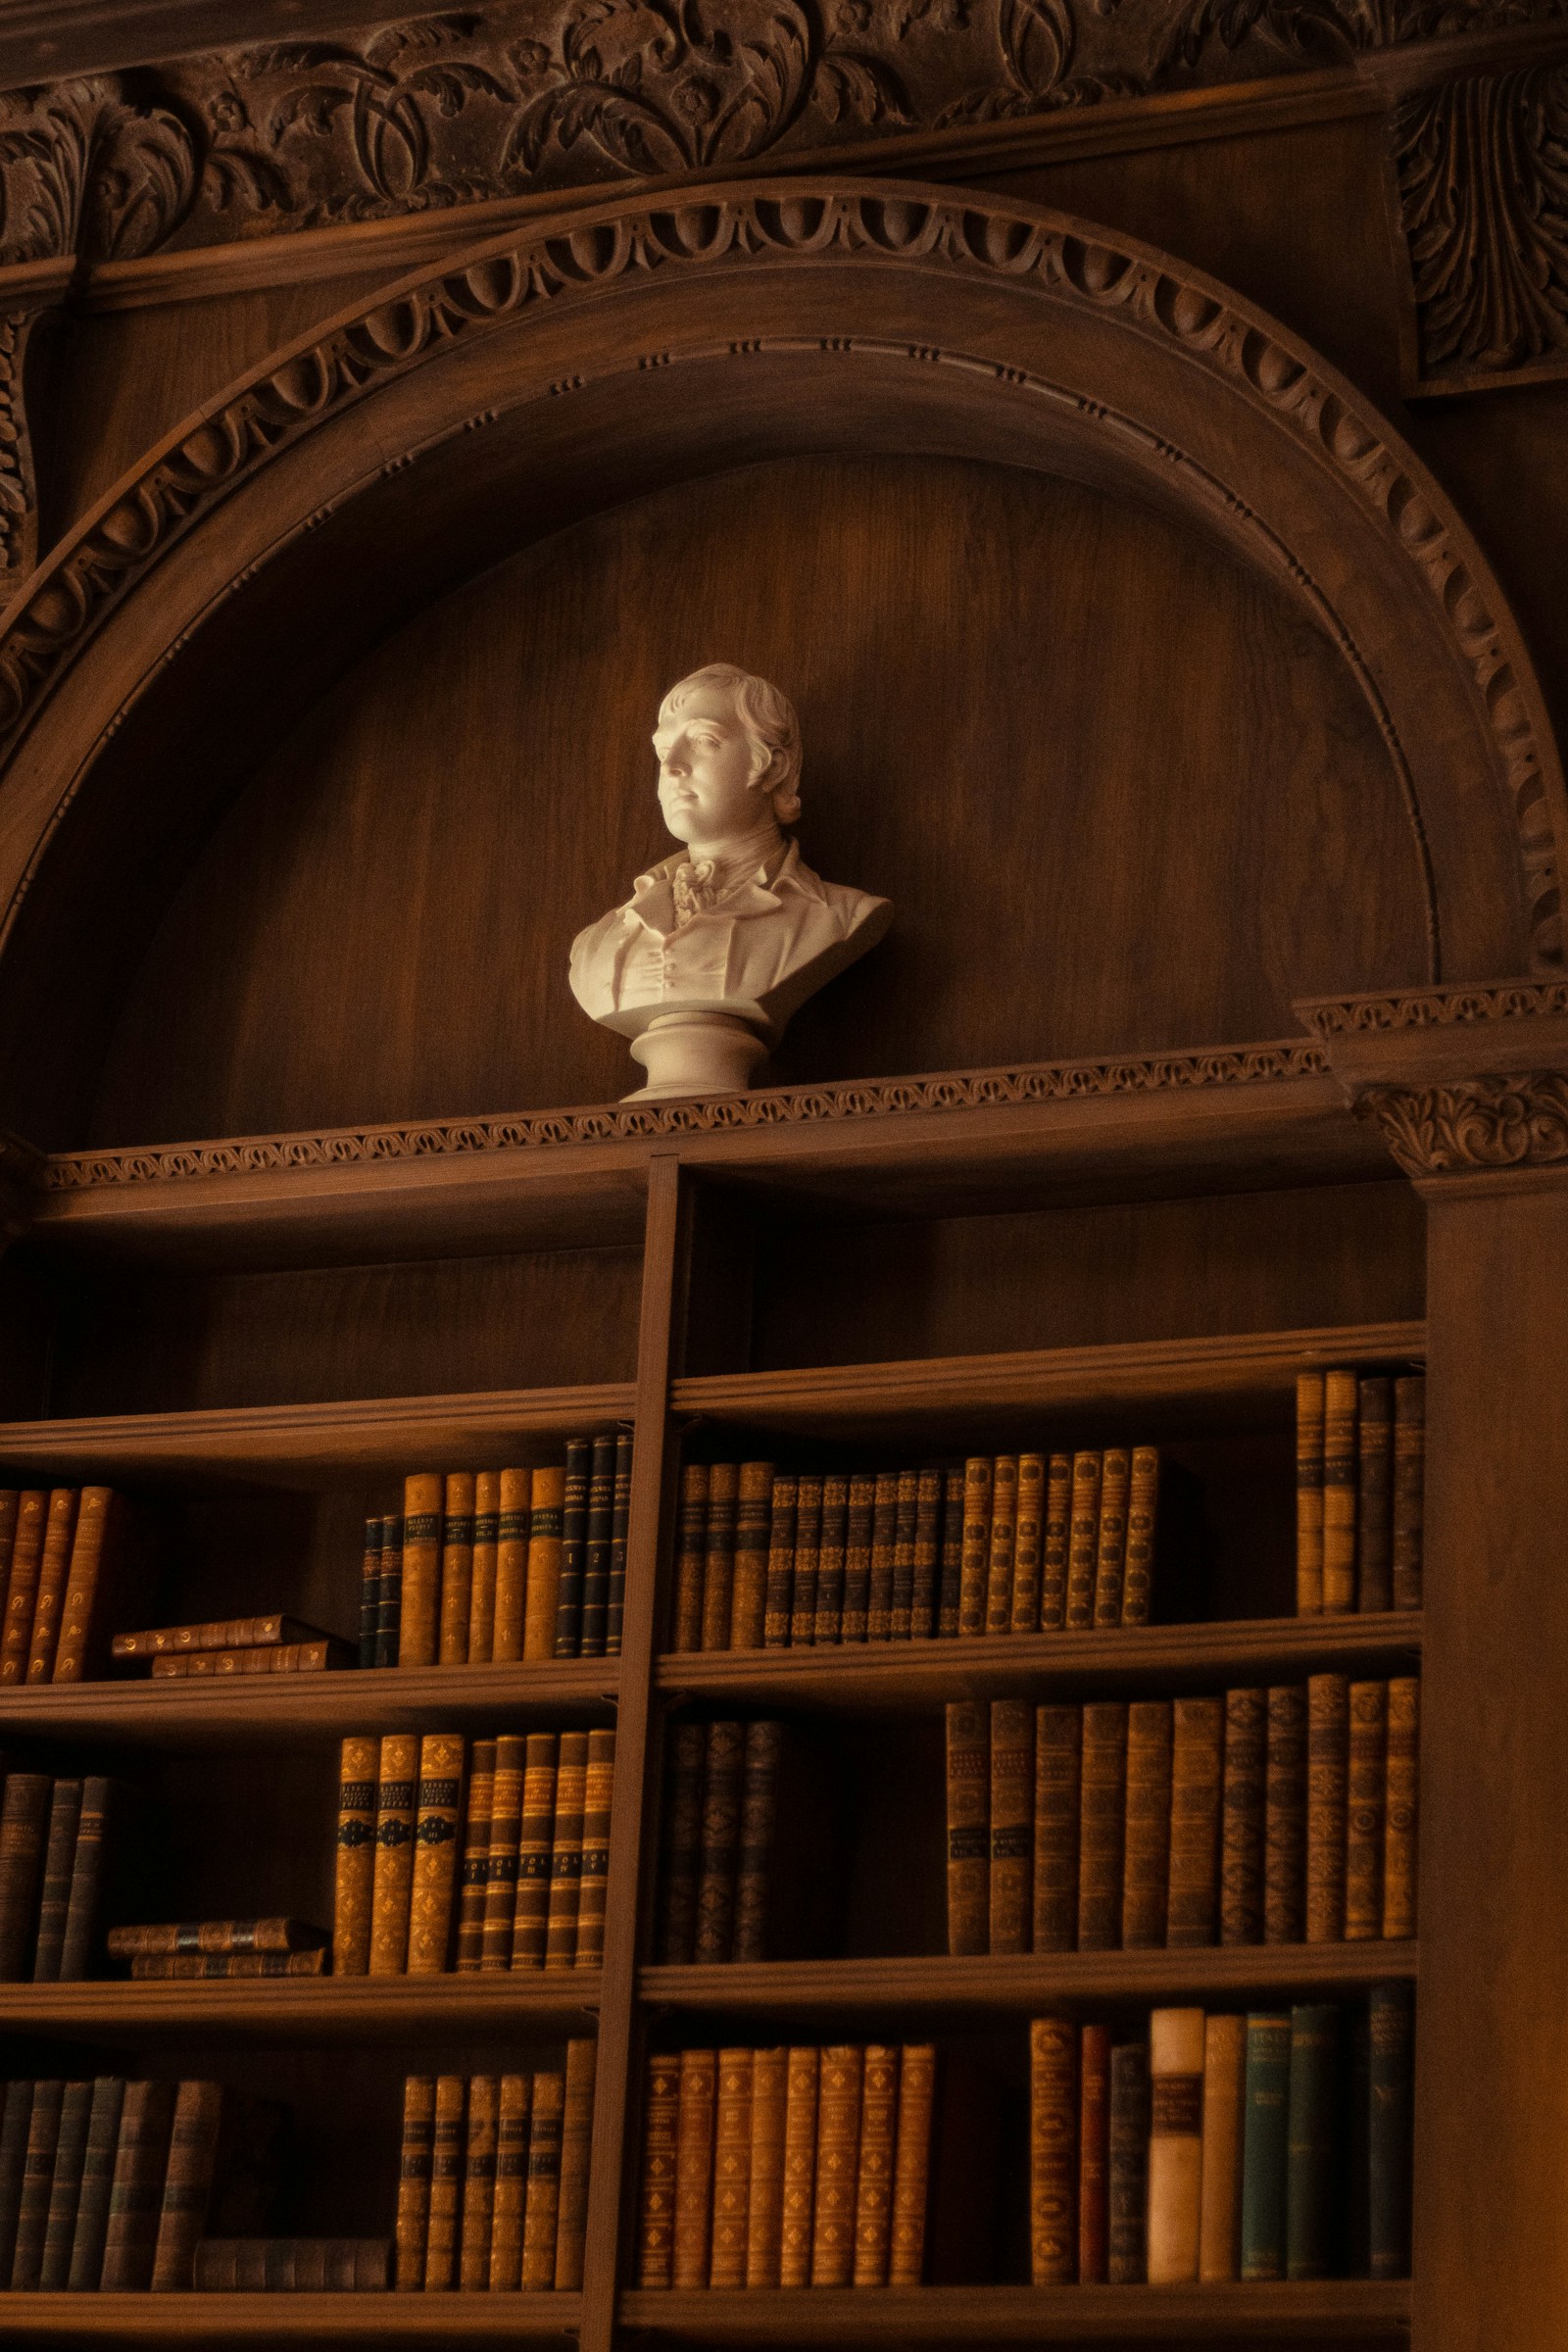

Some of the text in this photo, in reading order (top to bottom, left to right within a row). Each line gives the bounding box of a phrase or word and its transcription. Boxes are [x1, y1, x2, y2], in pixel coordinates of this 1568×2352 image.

[568, 1552, 573, 1564] 1
[593, 1552, 600, 1563] 2
[520, 1857, 545, 1866] VOL
[583, 1853, 607, 1862] VOL
[489, 1859, 513, 1868] VOL
[591, 1861, 597, 1870] V
[561, 1864, 568, 1873] IV
[471, 1871, 476, 1880] I
